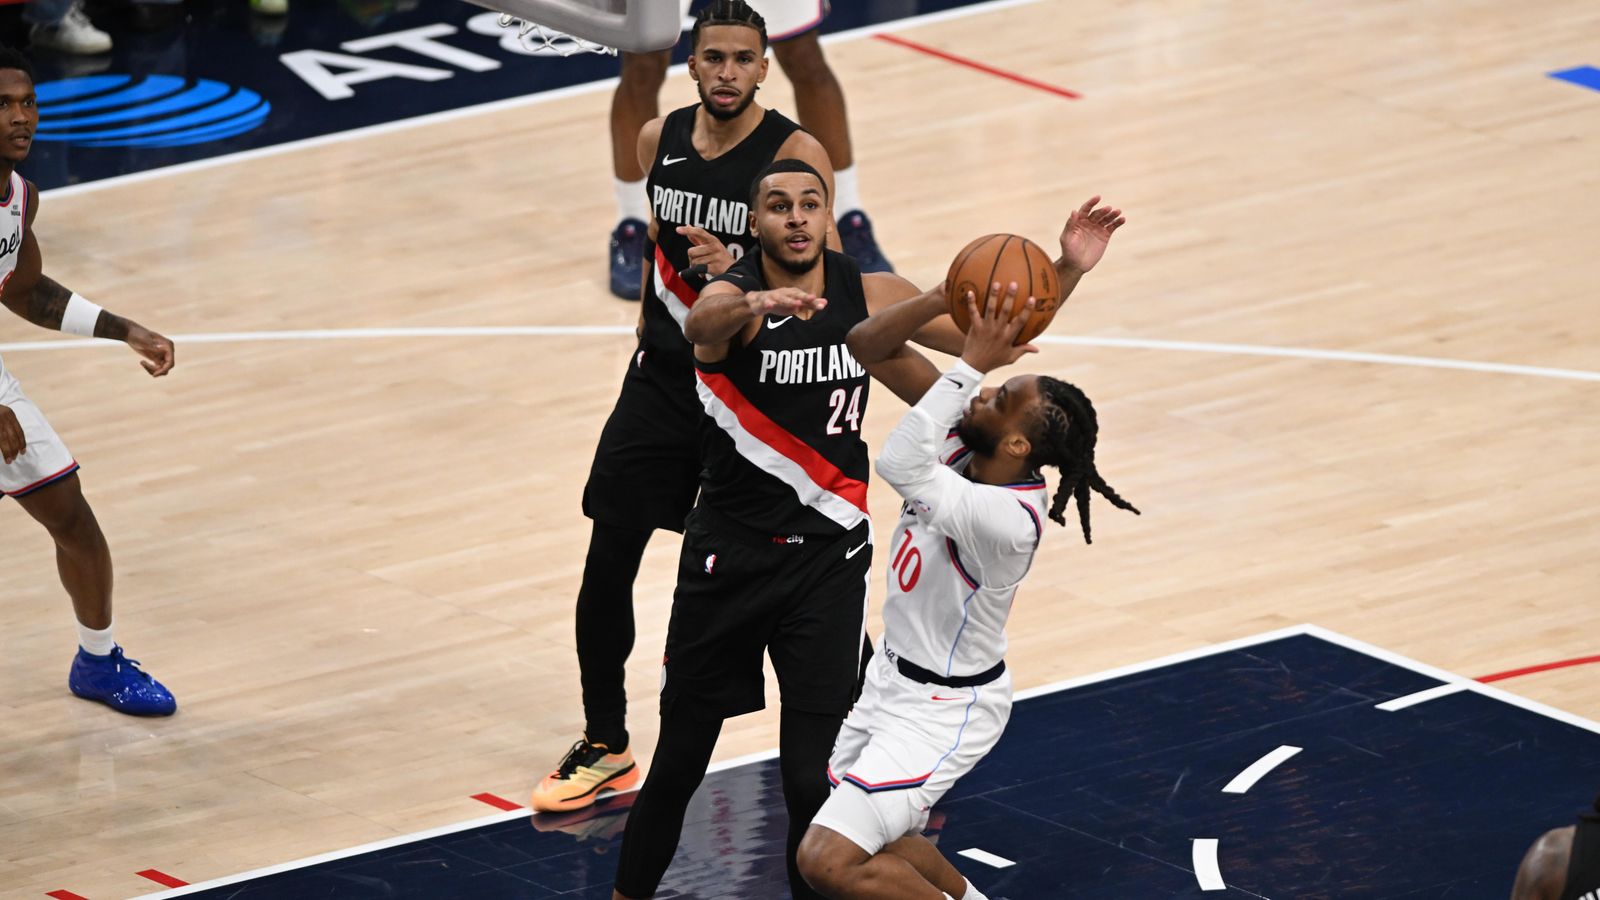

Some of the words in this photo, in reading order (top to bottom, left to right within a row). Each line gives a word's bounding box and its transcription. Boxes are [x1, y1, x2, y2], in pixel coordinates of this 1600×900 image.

[653, 184, 748, 236] PORTLAND
[826, 385, 863, 436] 24
[892, 528, 922, 593] 10
